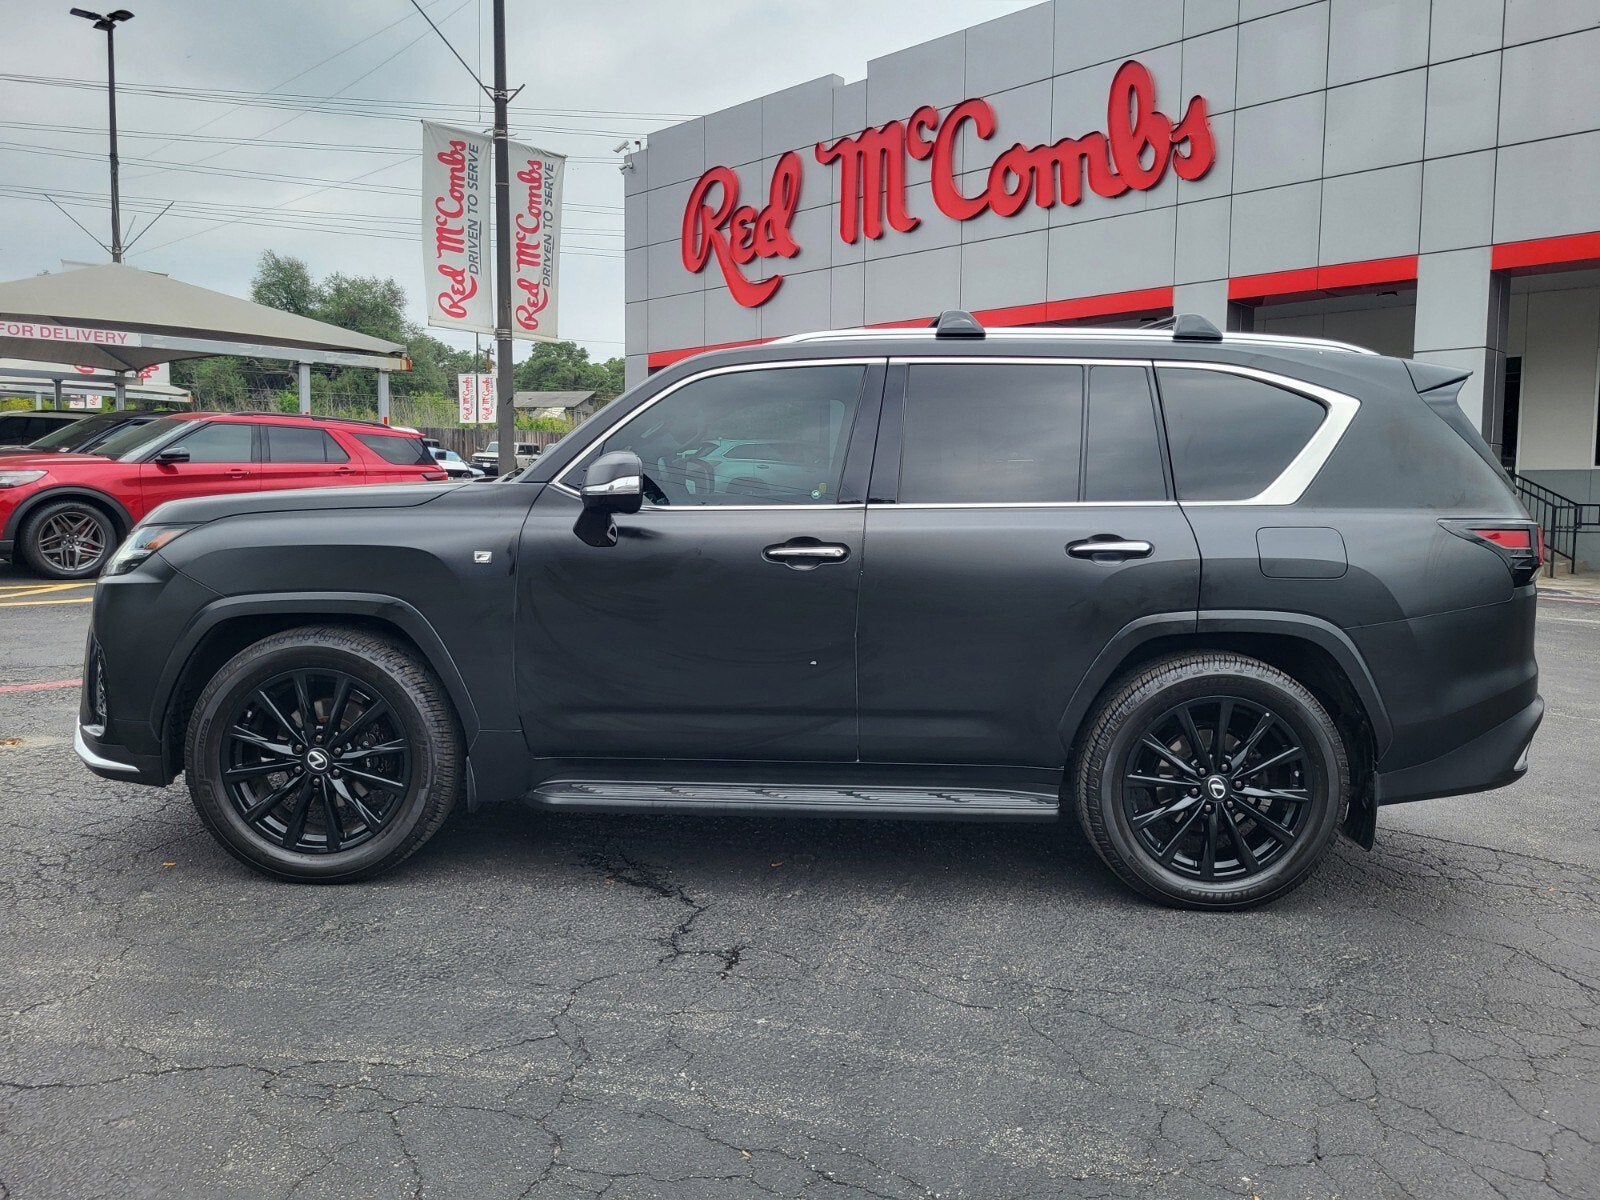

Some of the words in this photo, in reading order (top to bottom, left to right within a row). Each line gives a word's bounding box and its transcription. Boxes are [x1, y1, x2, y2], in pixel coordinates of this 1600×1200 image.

[467, 142, 479, 191] SERVE
[544, 161, 555, 207] SERVE
[681, 151, 801, 308] Red
[815, 59, 1215, 245] McCombs
[435, 140, 467, 259] McCombs
[467, 194, 479, 215] TO
[515, 159, 543, 273] McCombs
[543, 210, 554, 232] TO
[468, 220, 480, 276] DRIVEN
[543, 235, 553, 288] DRIVEN
[438, 264, 478, 319] Red
[515, 278, 548, 331] Red
[39, 326, 128, 345] DELIVERY
